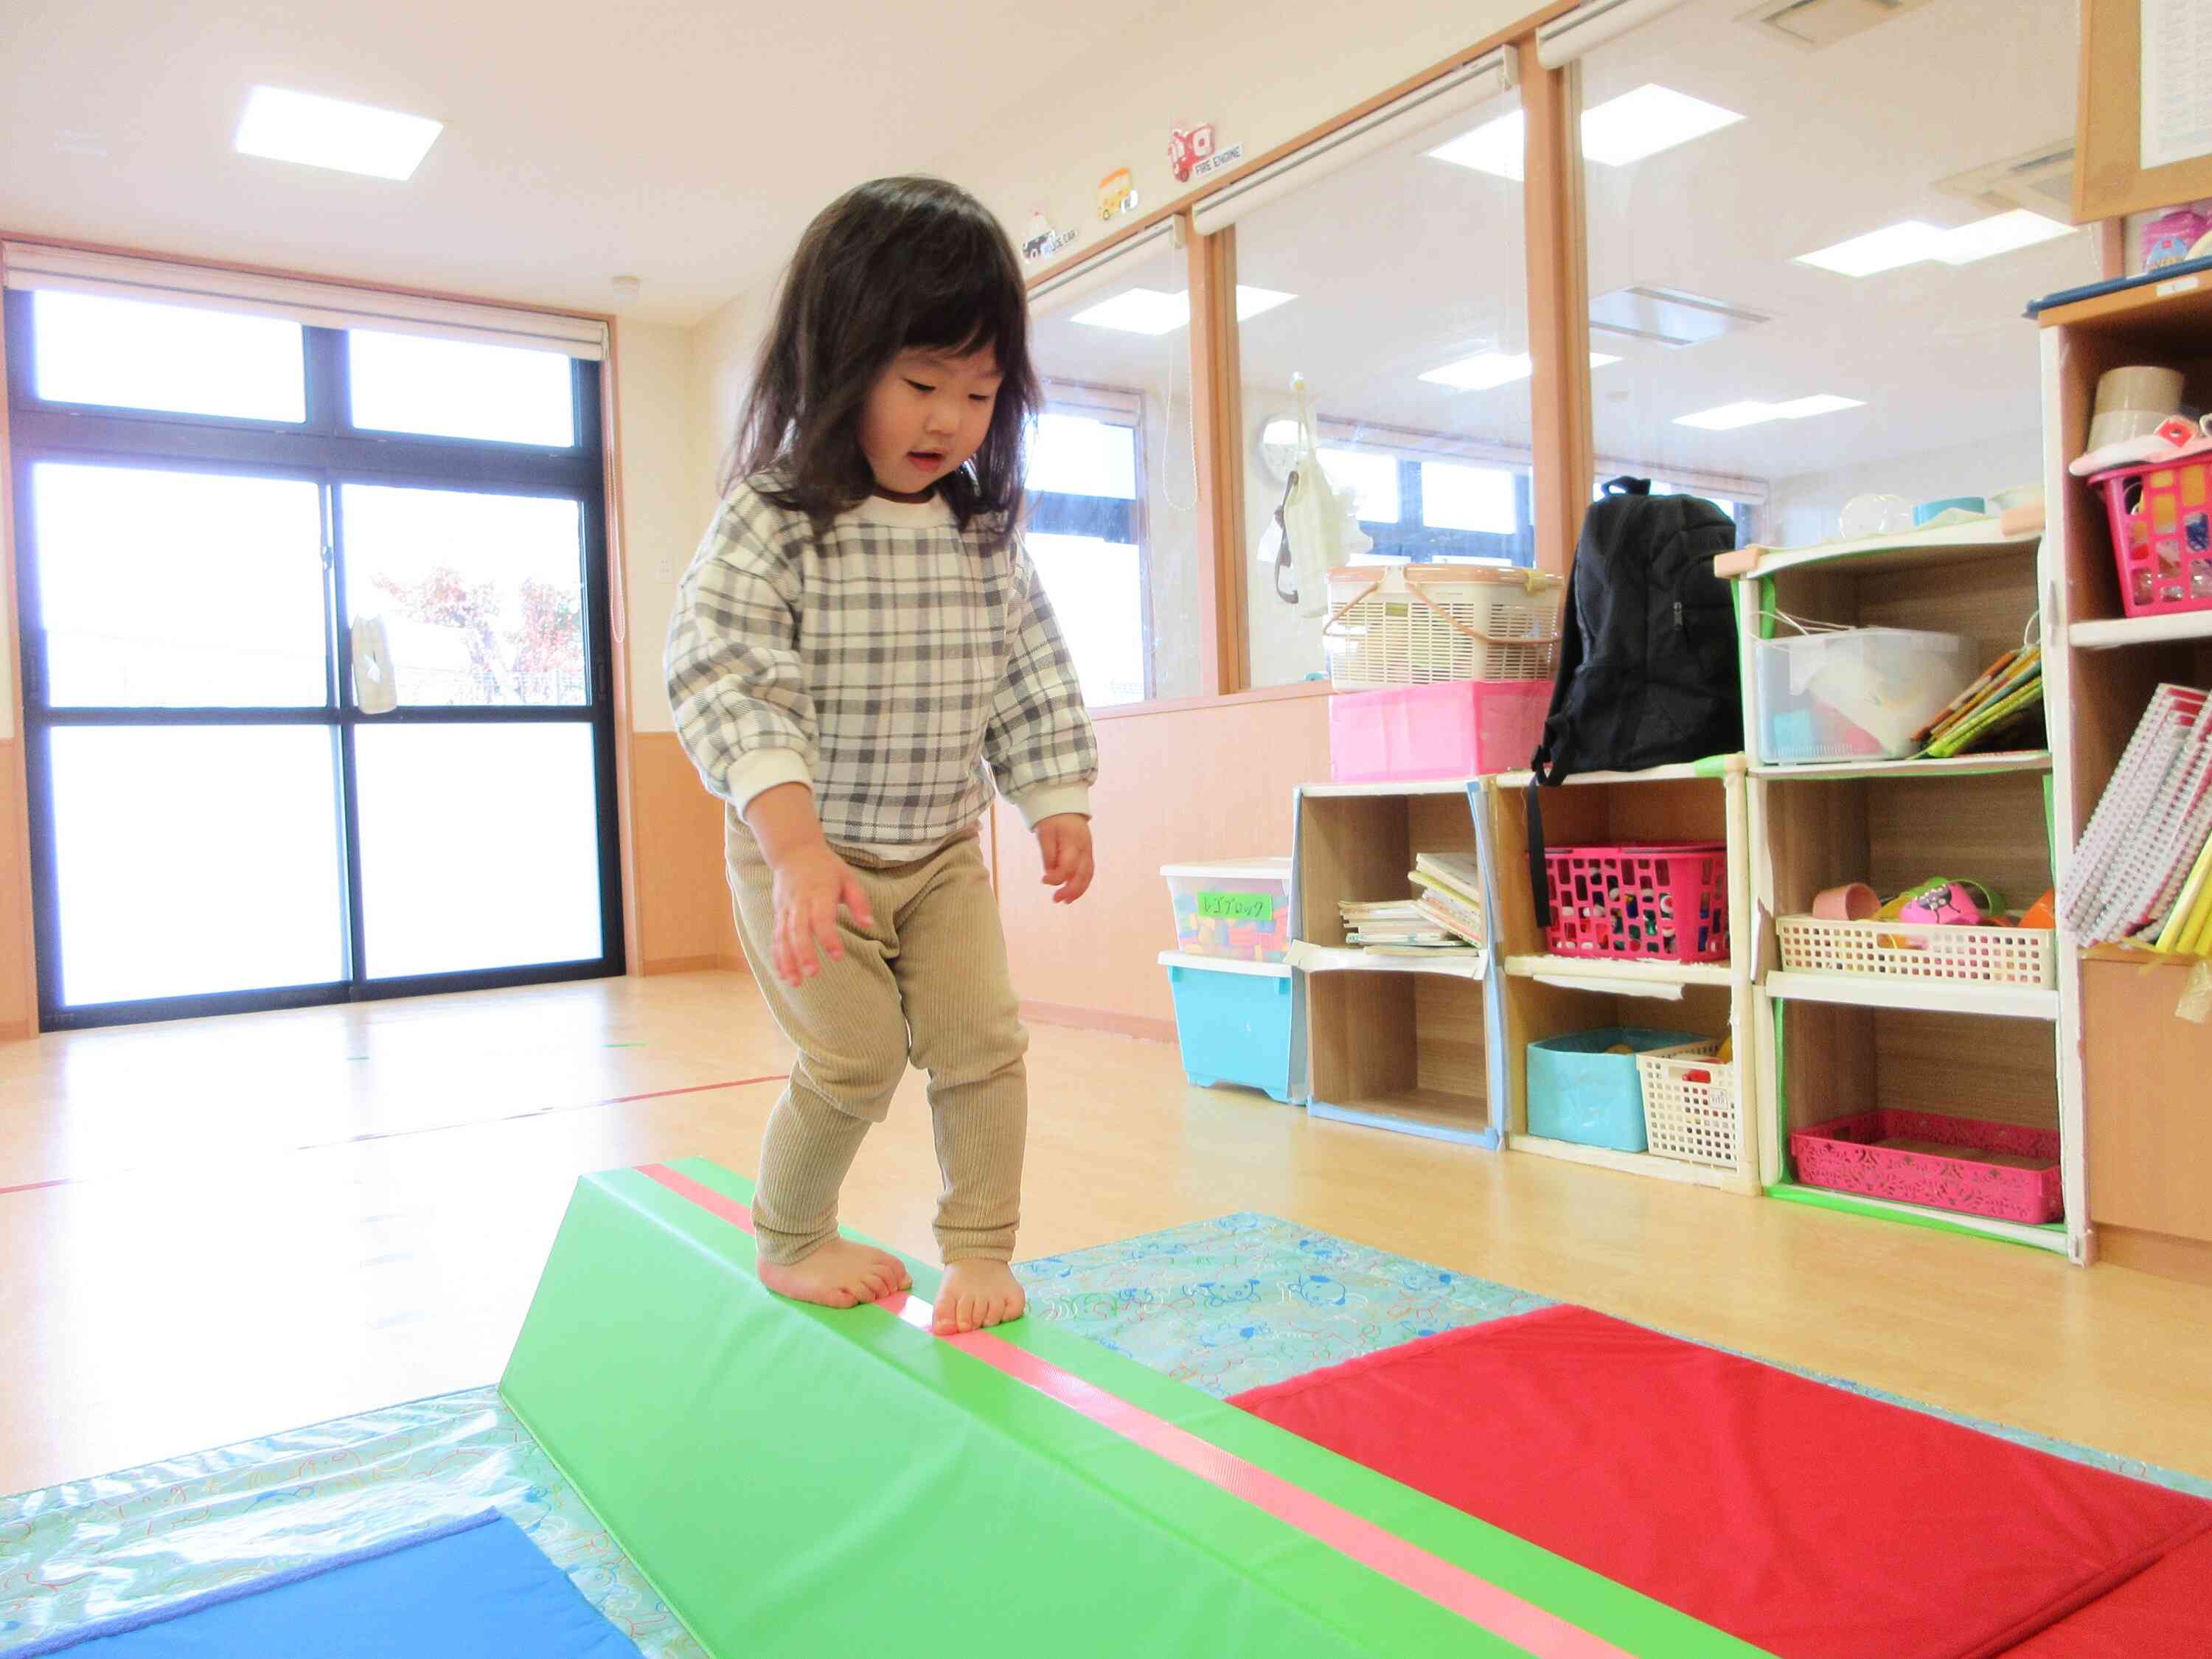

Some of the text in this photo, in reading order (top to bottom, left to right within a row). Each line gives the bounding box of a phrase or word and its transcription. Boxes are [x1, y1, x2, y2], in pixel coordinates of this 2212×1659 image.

[1194, 145, 1240, 175] FIRE ENGINE
[1203, 896, 1263, 917] レゴブロック
